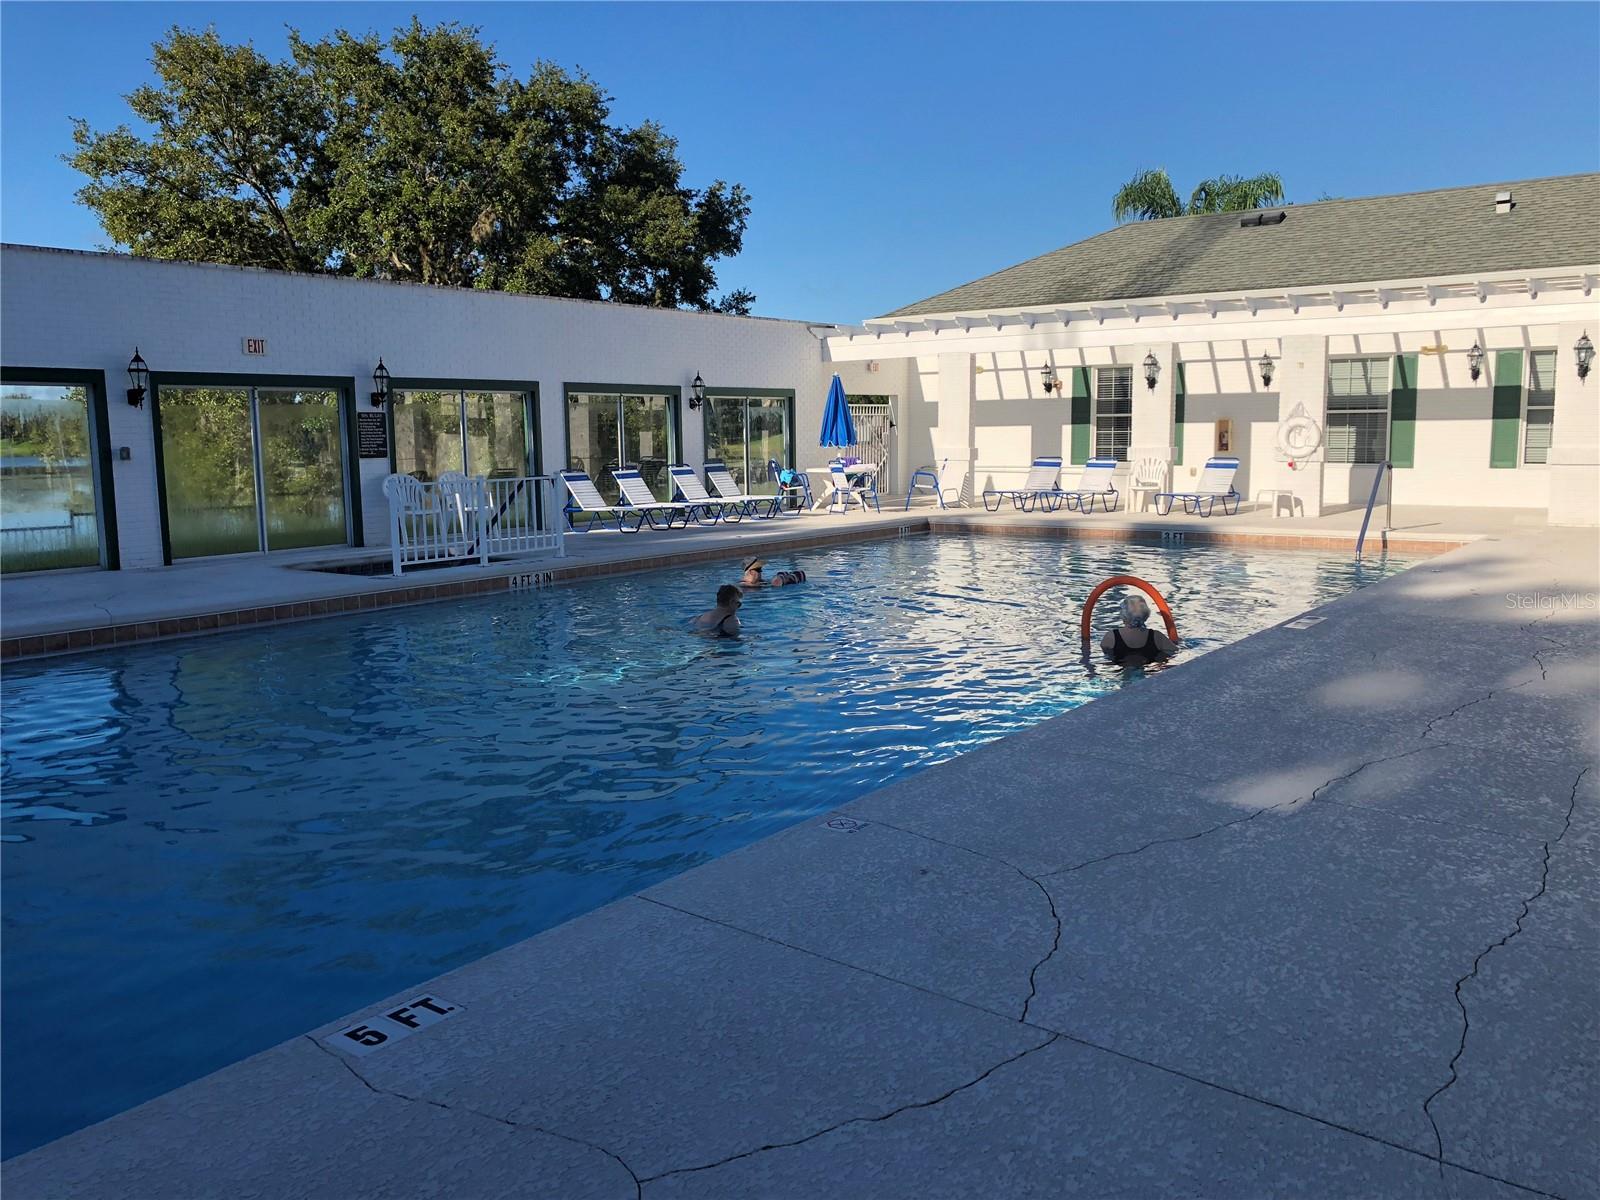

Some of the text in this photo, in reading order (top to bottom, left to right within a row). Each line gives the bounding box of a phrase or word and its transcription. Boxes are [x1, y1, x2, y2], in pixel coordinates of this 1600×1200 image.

[247, 338, 265, 354] EXIT
[512, 576, 518, 588] 4
[534, 573, 540, 584] 3
[344, 997, 455, 1046] 5 FT.
